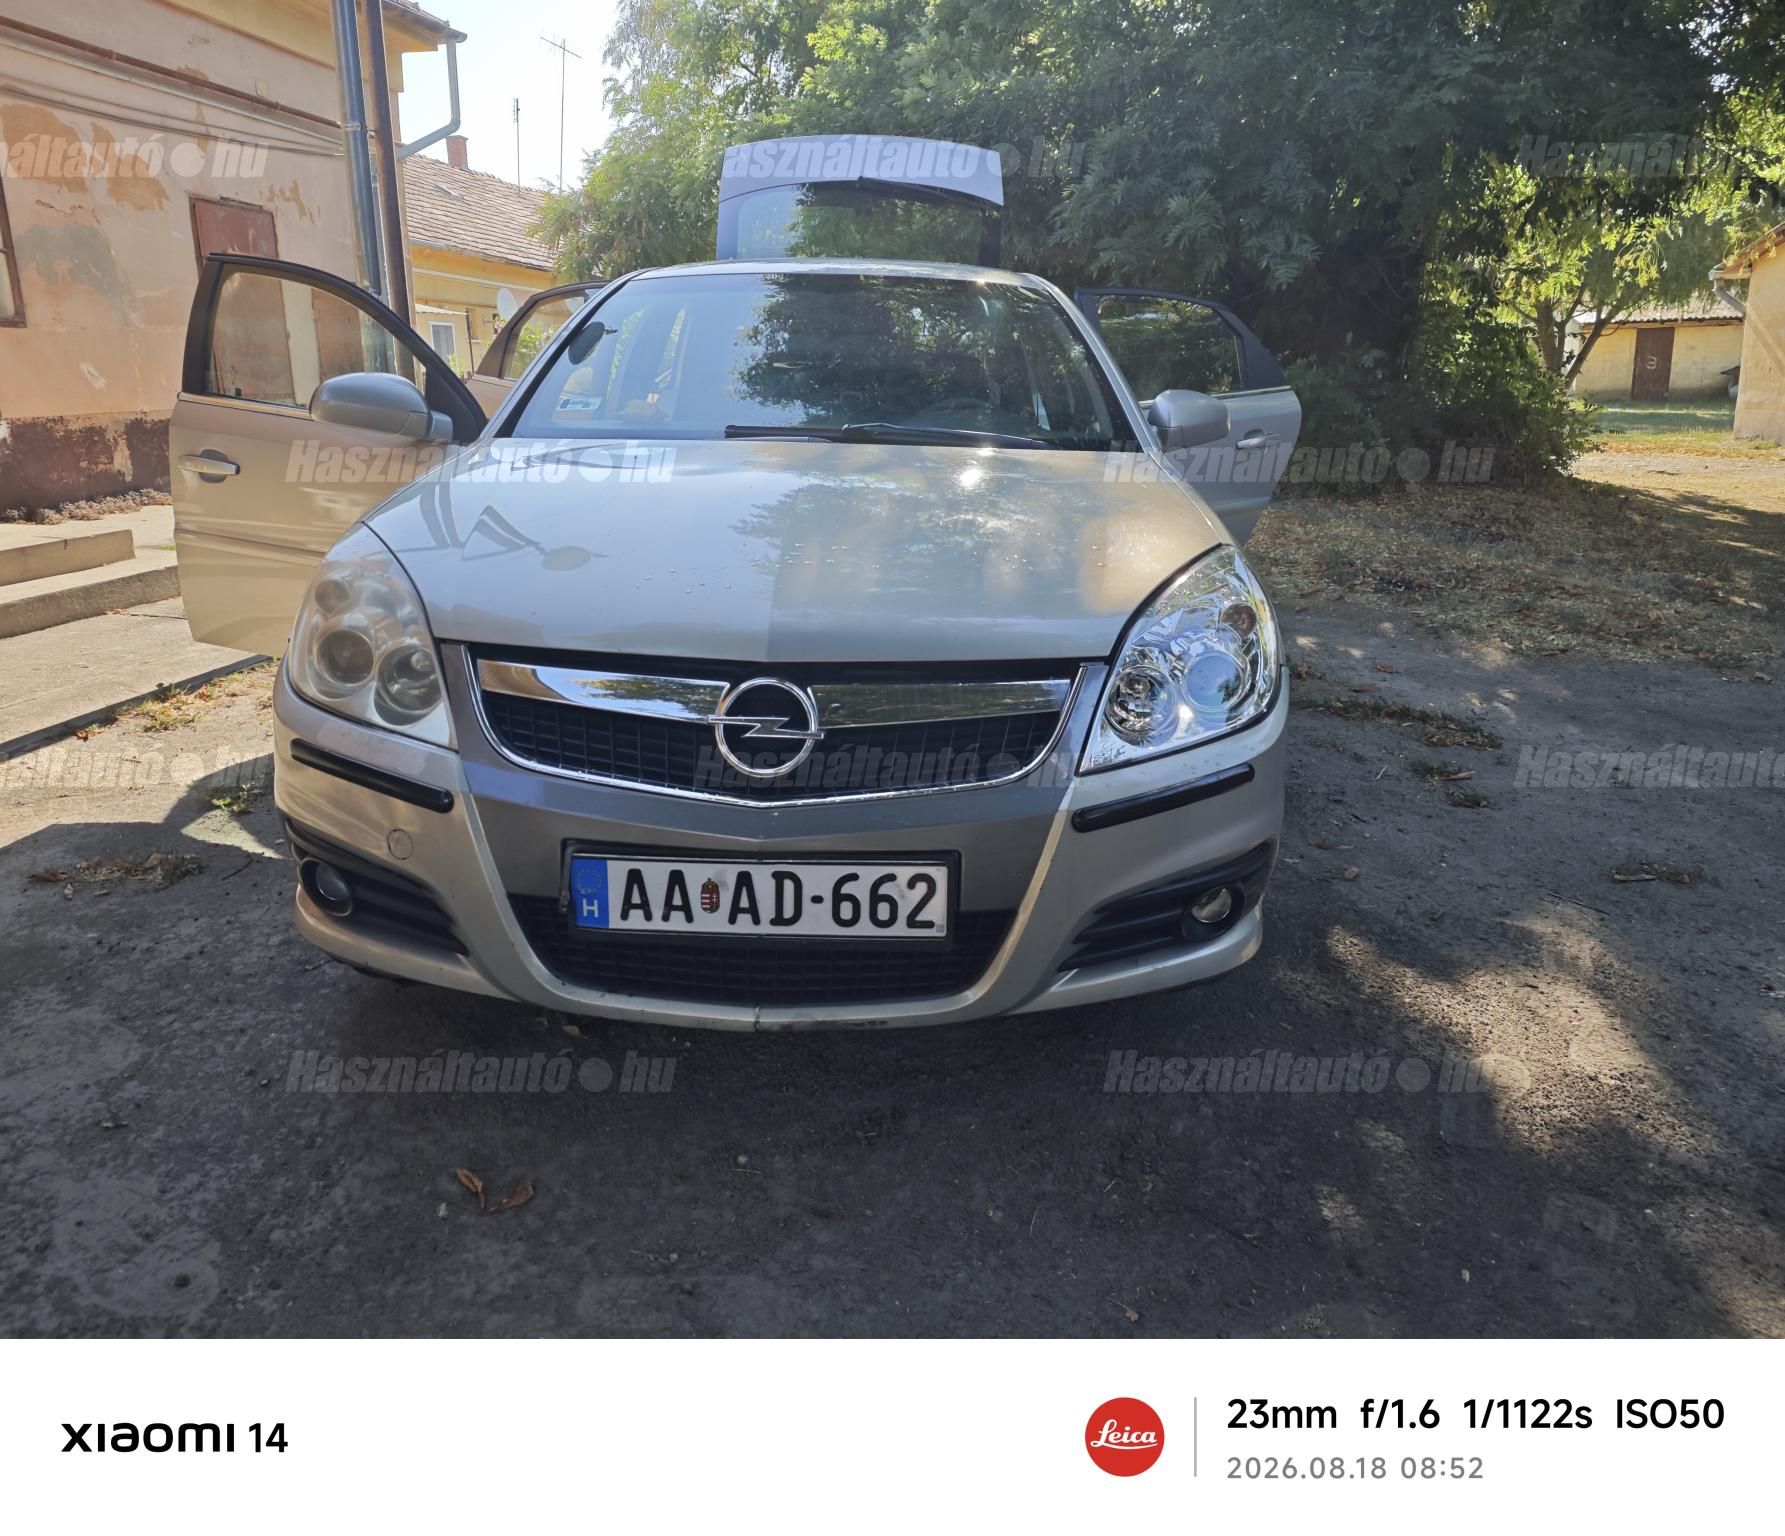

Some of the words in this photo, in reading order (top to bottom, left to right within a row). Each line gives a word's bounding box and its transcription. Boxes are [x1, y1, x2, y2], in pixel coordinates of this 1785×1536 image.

[582, 899, 599, 919] H
[619, 868, 694, 924] AA
[728, 870, 938, 929] AD-662
